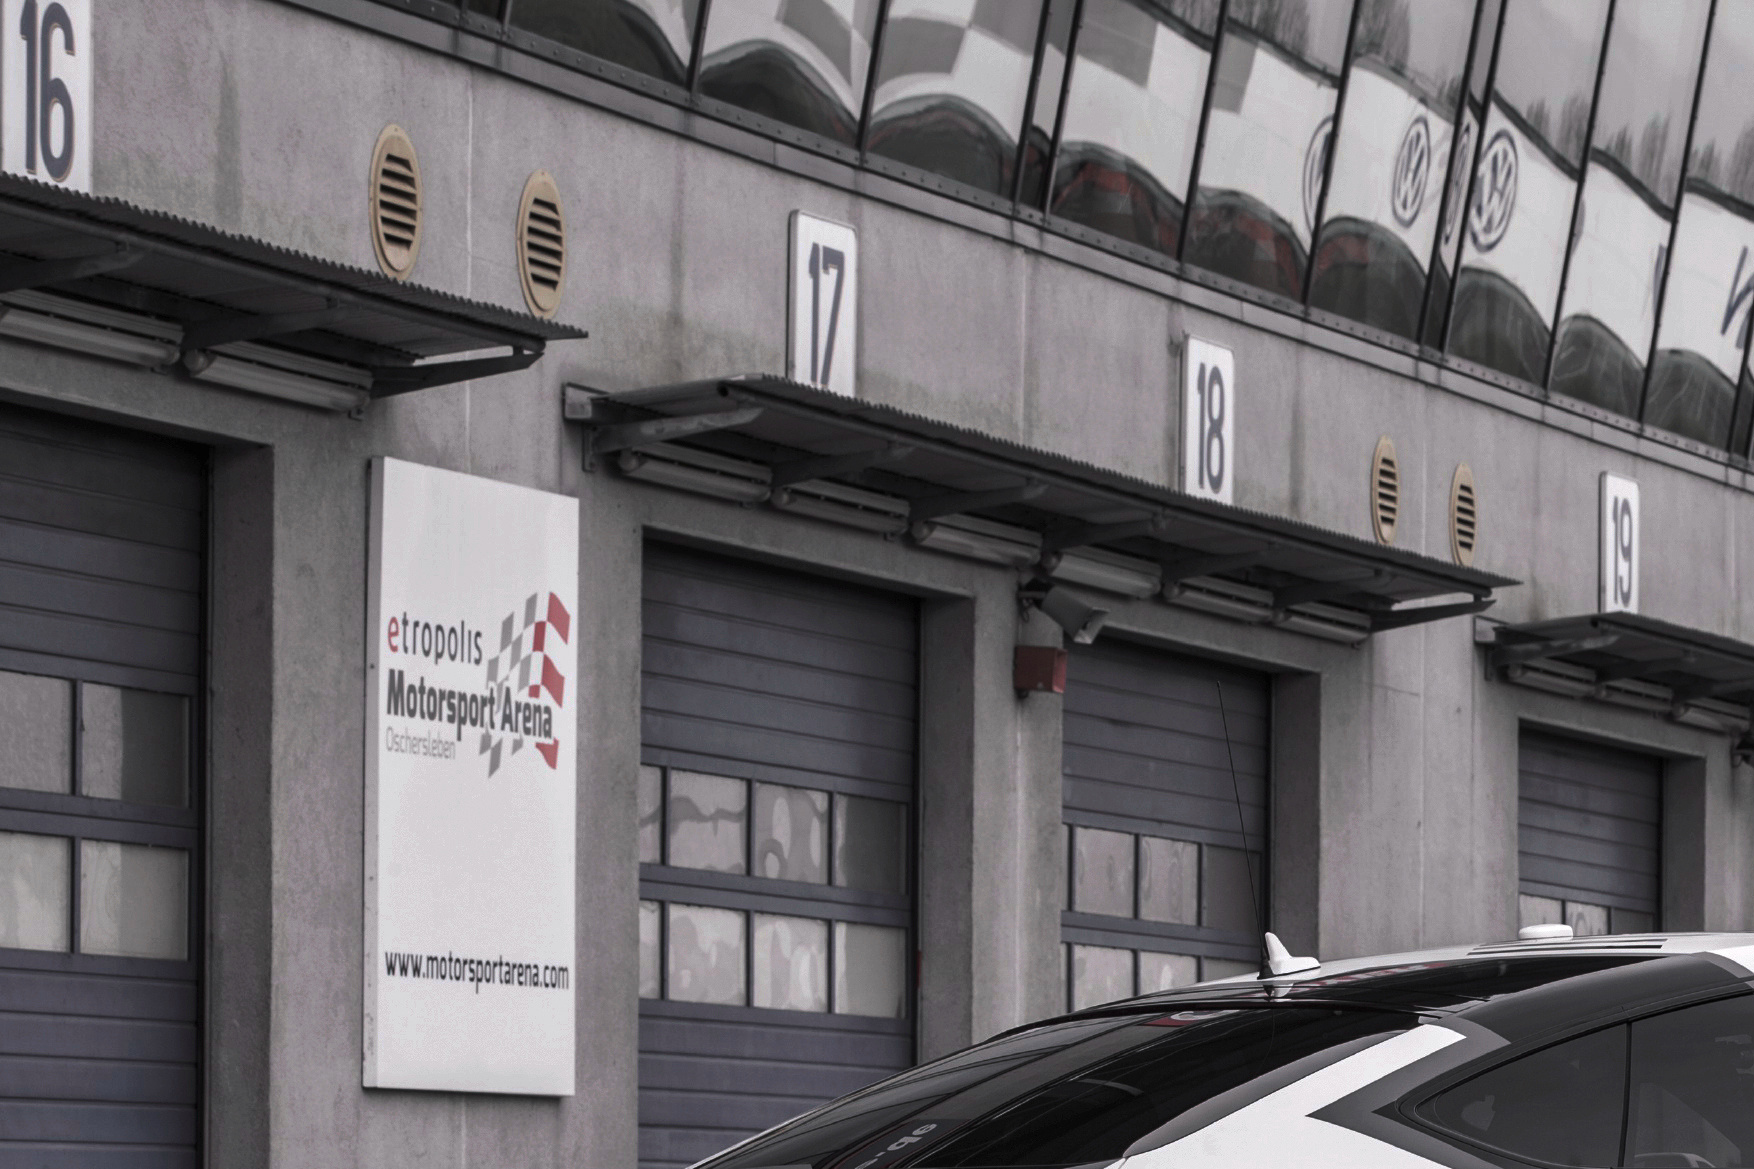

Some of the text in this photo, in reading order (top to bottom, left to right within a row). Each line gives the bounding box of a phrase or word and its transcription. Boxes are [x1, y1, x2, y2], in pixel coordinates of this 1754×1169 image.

[20, 0, 75, 183] 16
[808, 242, 845, 389] 17
[1198, 361, 1225, 495] 18
[1612, 495, 1633, 608] 19
[387, 611, 483, 666] etropolis
[386, 725, 456, 760] Oschersleben
[387, 668, 553, 742] Motorsport Arena
[385, 950, 570, 995] www.motorsportarena.com
